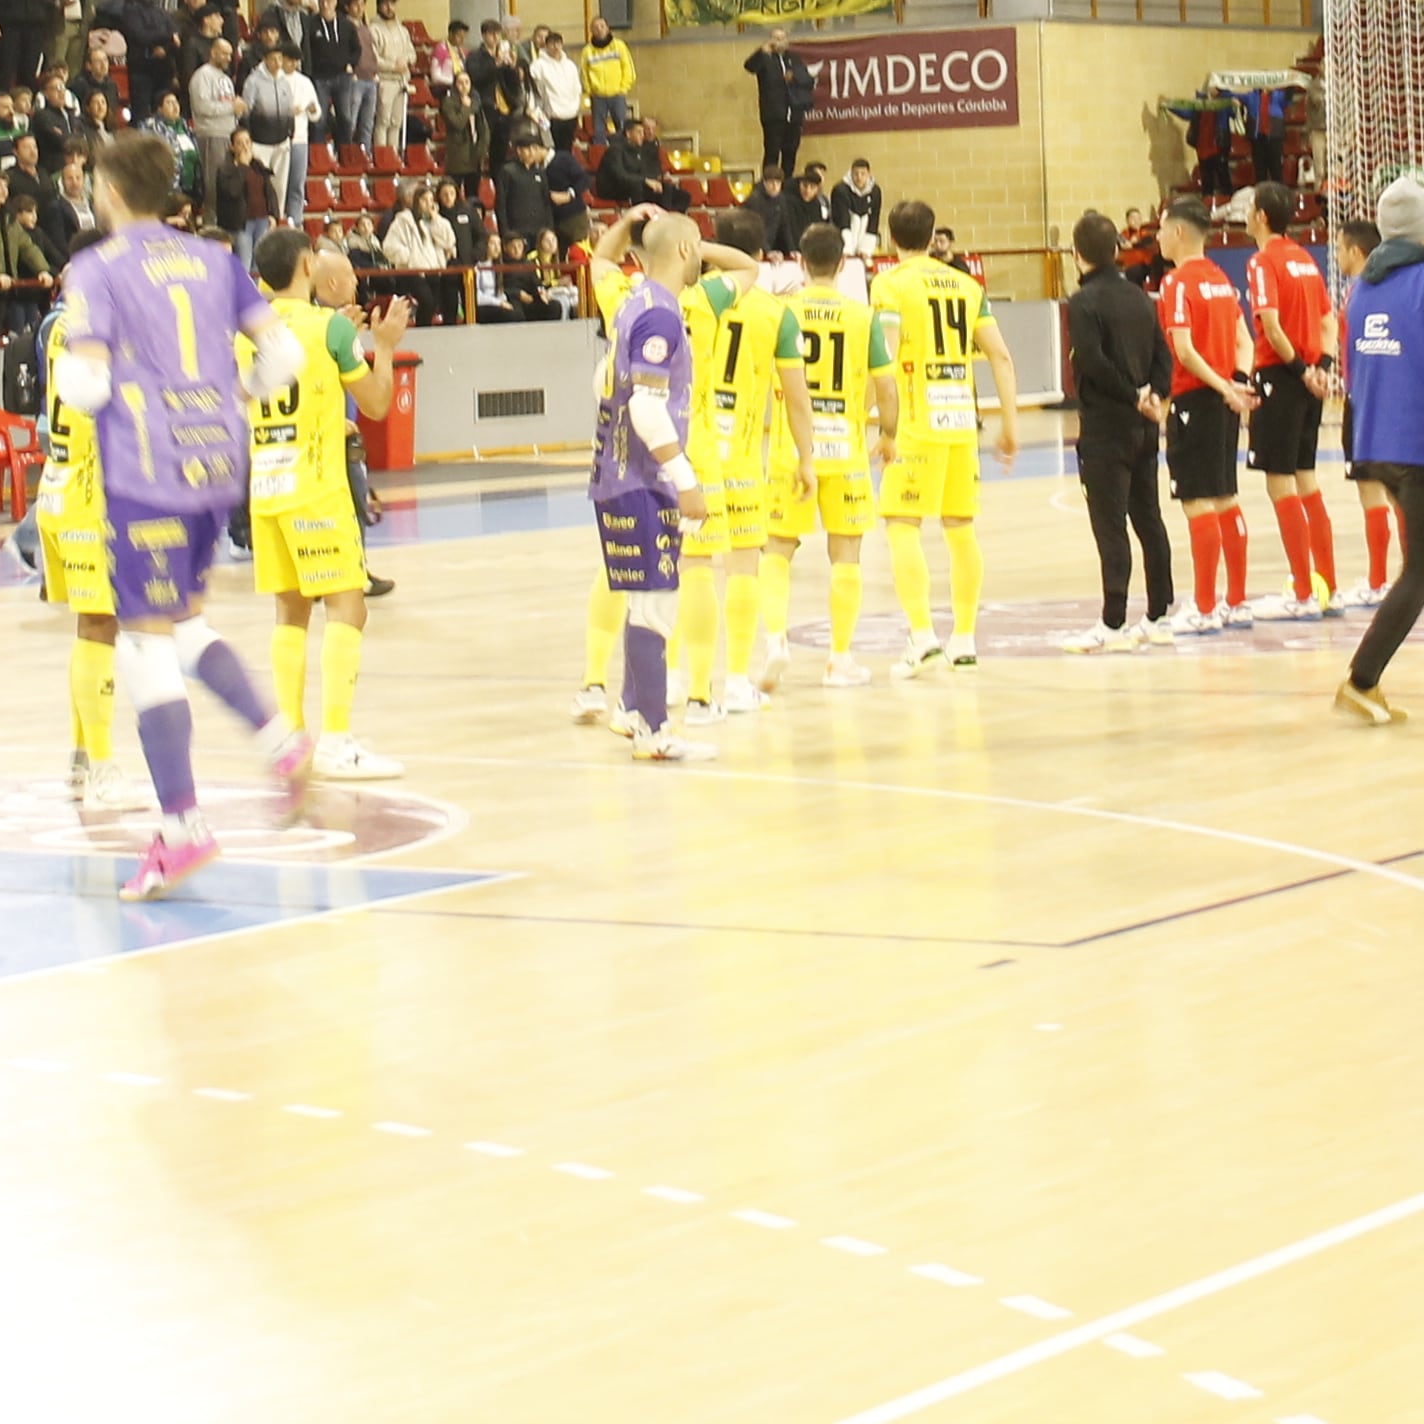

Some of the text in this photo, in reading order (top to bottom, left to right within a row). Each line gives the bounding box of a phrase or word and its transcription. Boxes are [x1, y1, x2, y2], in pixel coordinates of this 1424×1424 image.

[828, 47, 1009, 100] IMDECO
[825, 102, 883, 122] Municipal
[883, 102, 900, 118] de
[901, 100, 956, 119] Deportes
[956, 96, 1008, 114] Córdoba
[166, 282, 201, 382] 1
[928, 298, 967, 356] 14
[803, 330, 845, 393] 21
